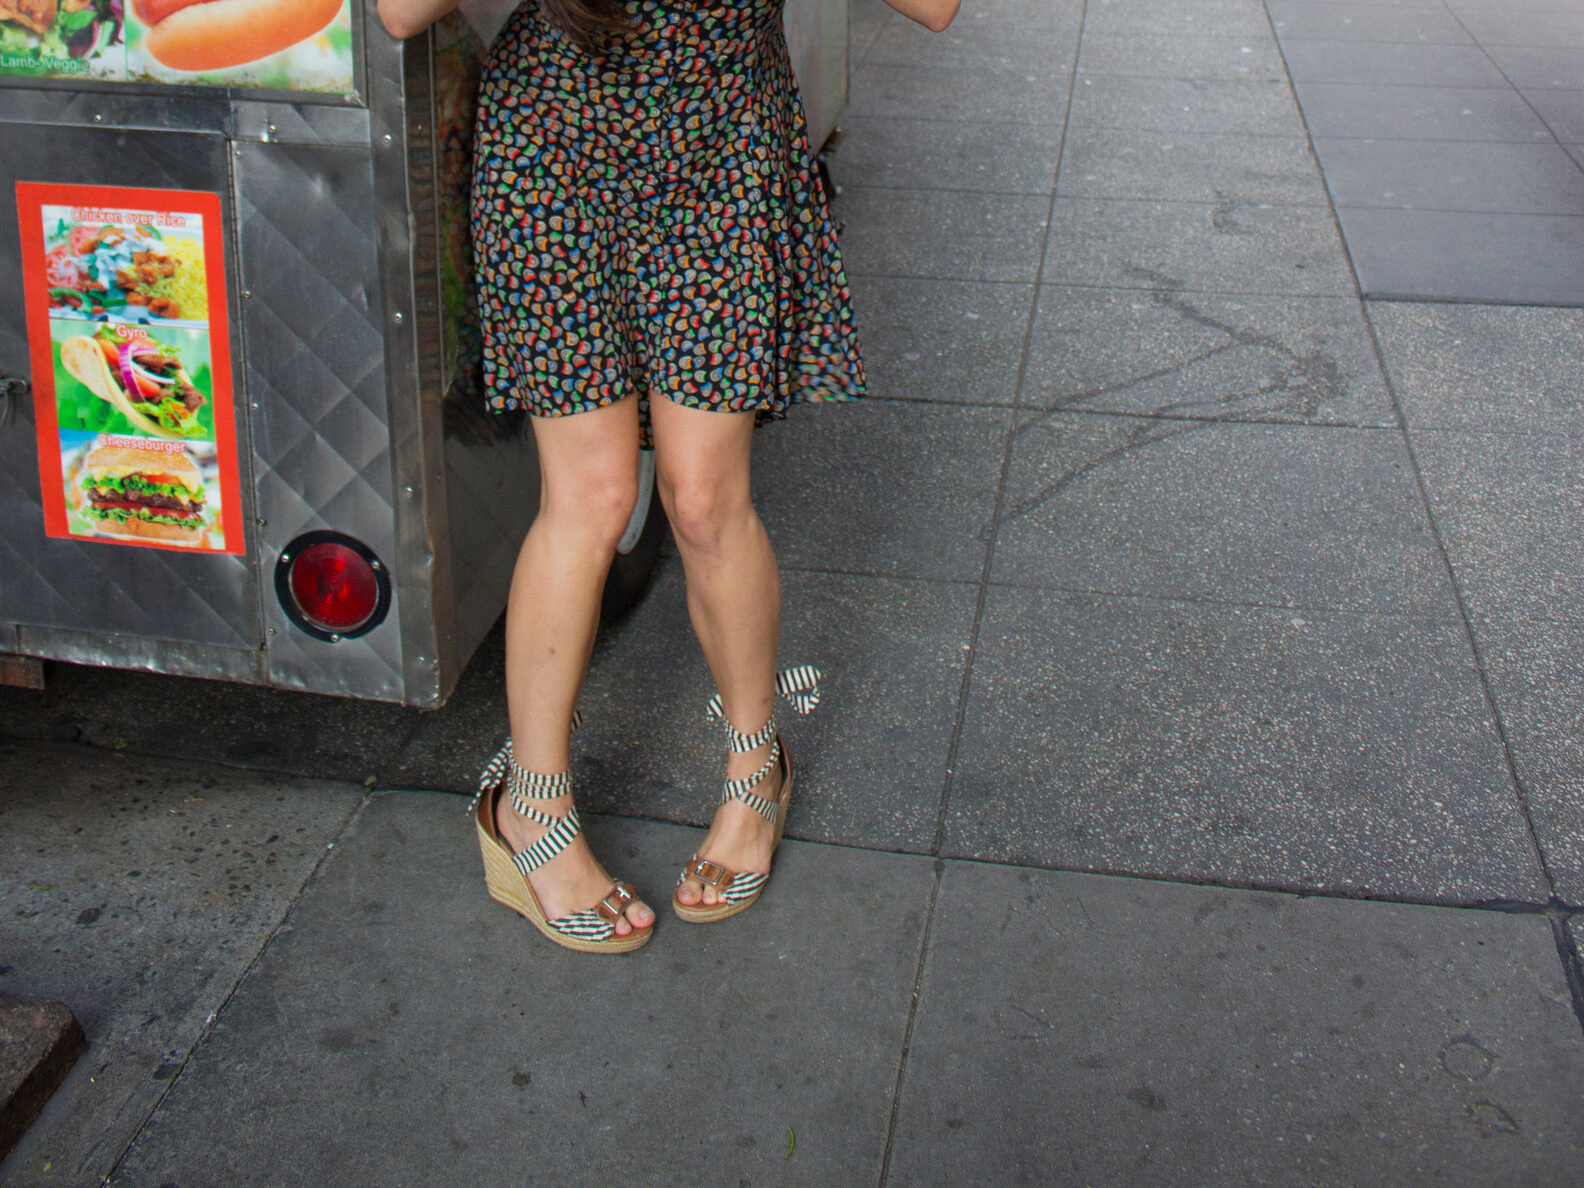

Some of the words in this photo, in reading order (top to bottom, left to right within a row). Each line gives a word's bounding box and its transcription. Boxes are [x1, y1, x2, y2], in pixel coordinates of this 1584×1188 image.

[71, 207, 122, 223] Chicken
[125, 213, 154, 226] over
[156, 212, 187, 228] Rice
[116, 324, 148, 341] Gyro
[98, 433, 187, 453] Cheeseburger
